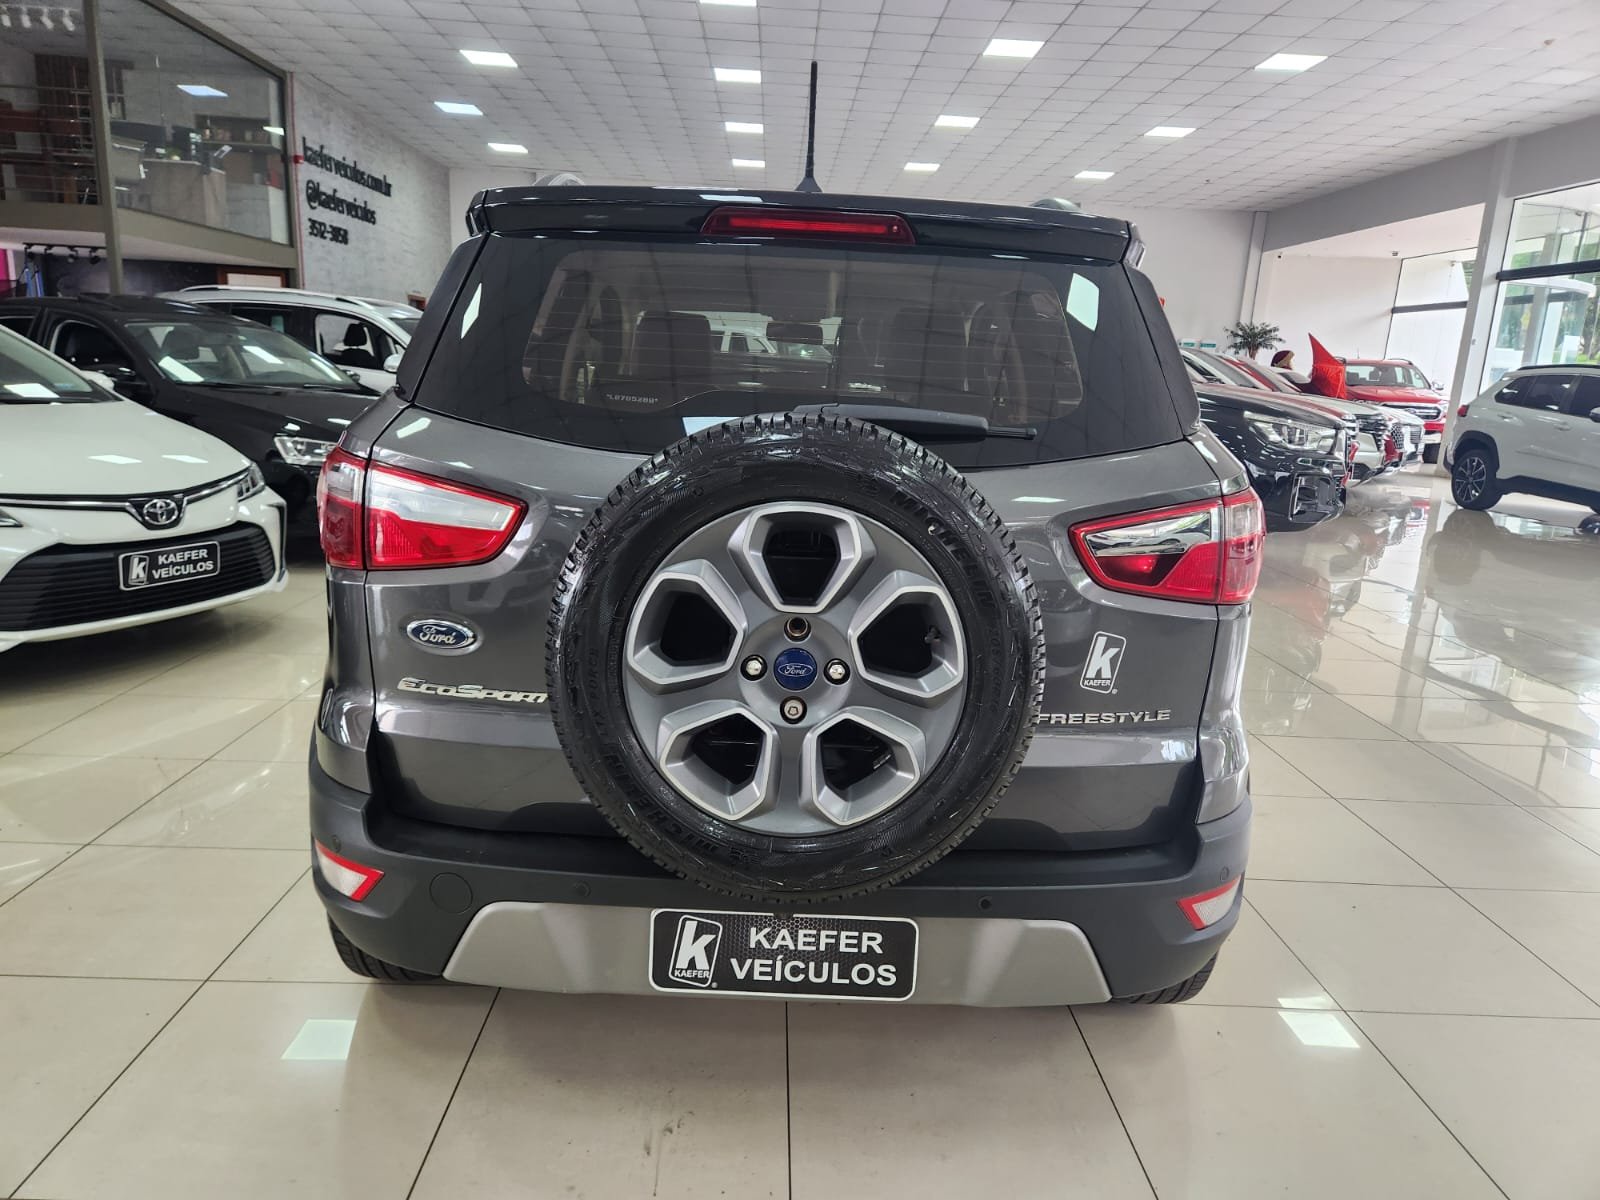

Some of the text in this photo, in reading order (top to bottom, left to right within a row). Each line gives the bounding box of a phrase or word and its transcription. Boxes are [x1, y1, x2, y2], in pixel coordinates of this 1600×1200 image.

[158, 549, 208, 565] KAEFER
[152, 561, 213, 579] VEÍCULOS
[419, 625, 456, 644] Ford
[784, 664, 807, 675] Ford
[1084, 679, 1111, 687] KAEFER
[1036, 709, 1171, 724] FREESTYLE
[749, 927, 883, 954] KAEFER
[674, 969, 711, 979] KAEFER
[730, 955, 898, 987] VEÍCULOS
